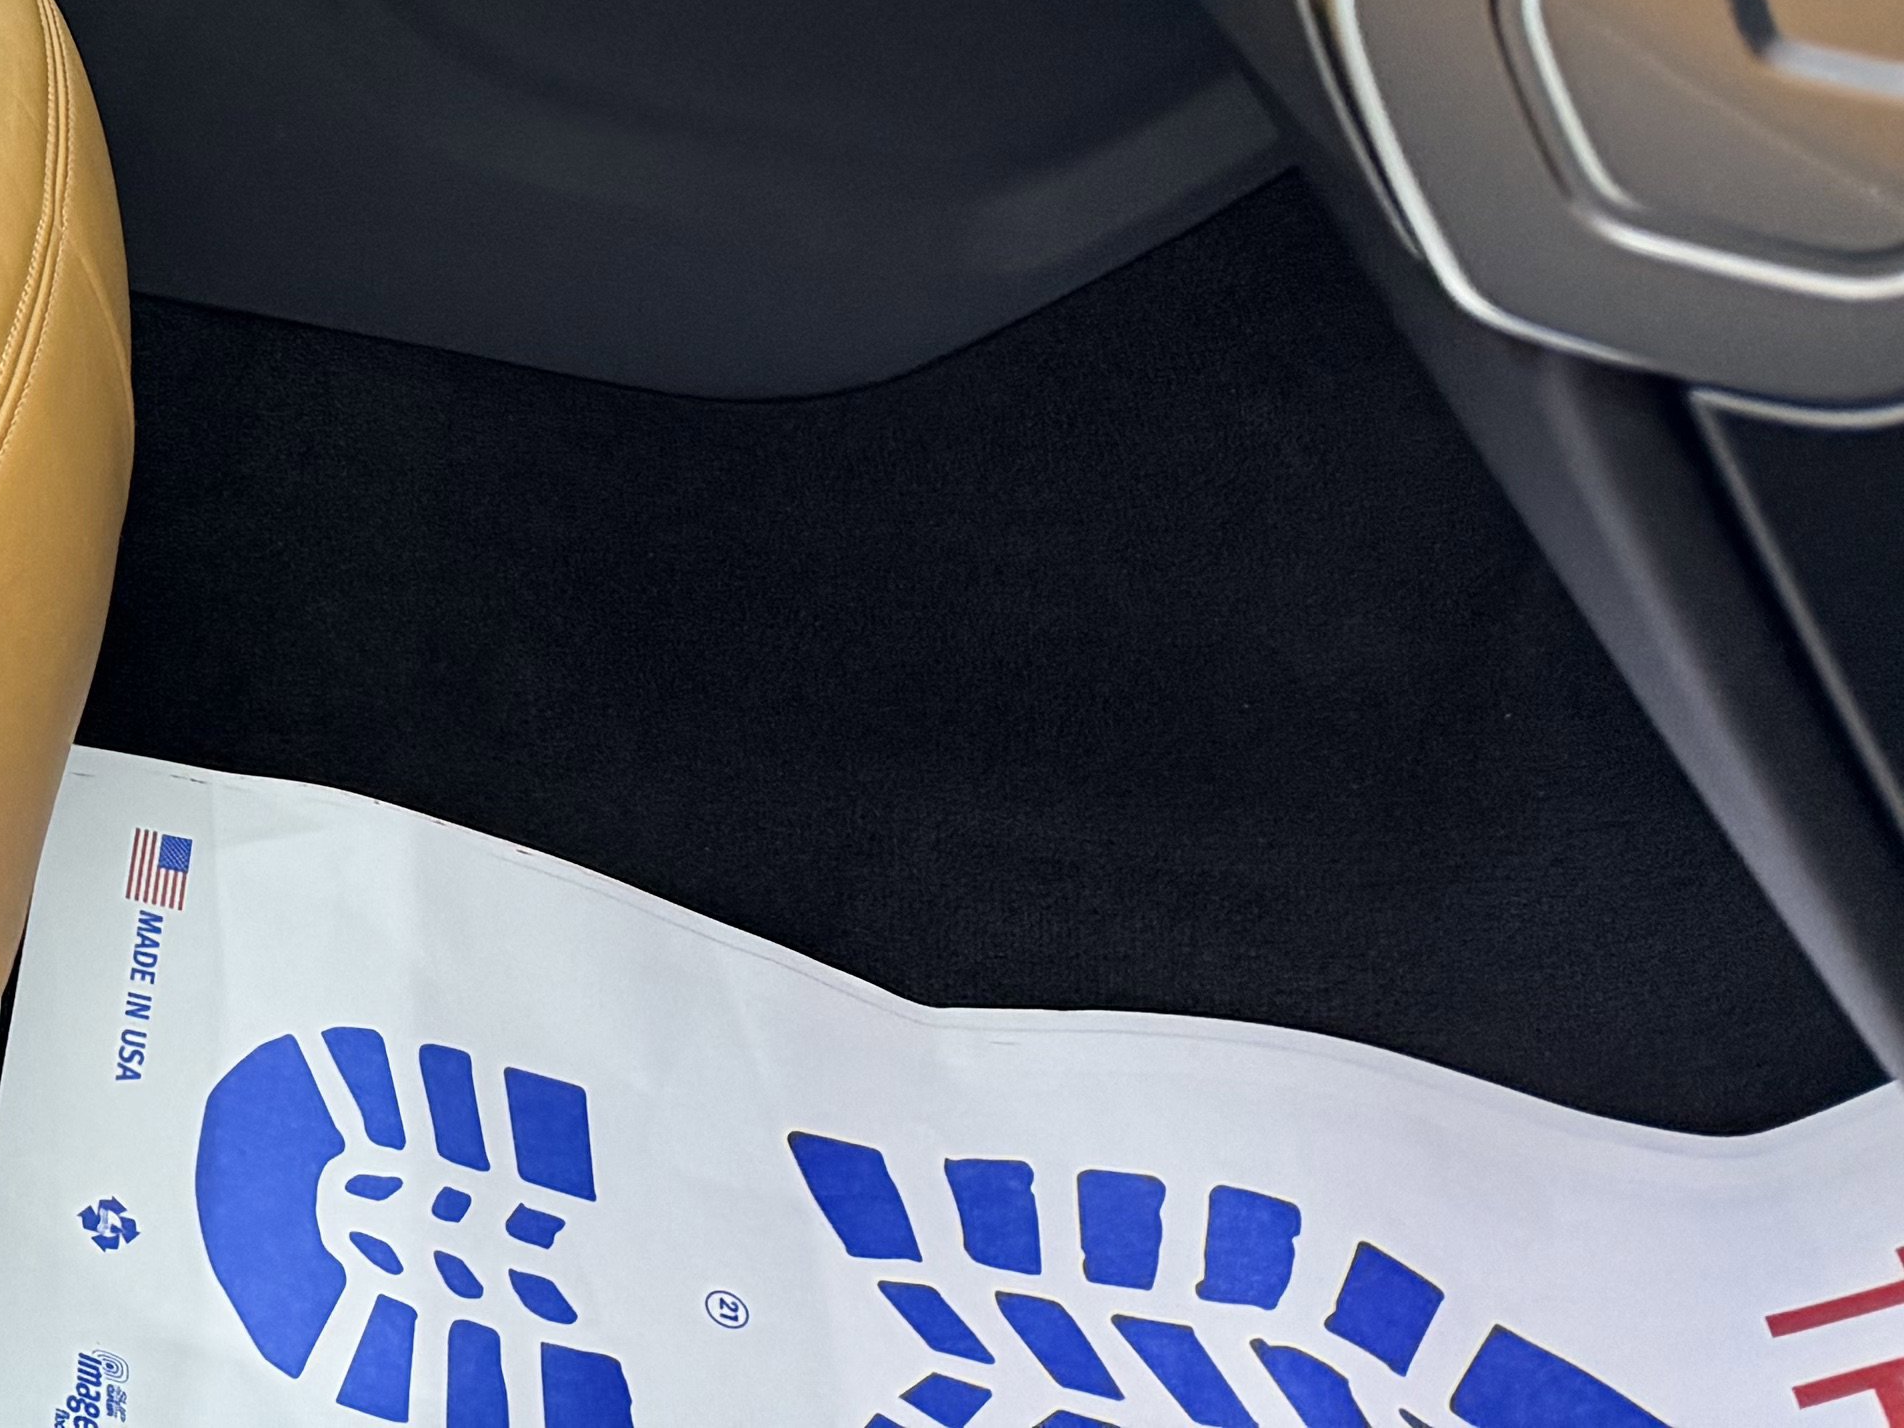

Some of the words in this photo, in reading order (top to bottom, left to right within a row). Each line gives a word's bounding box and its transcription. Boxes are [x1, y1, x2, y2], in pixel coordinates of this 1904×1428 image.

[130, 909, 164, 985] MADE
[125, 991, 153, 1020] IN
[115, 1029, 148, 1081] USA
[719, 1296, 739, 1323] 21
